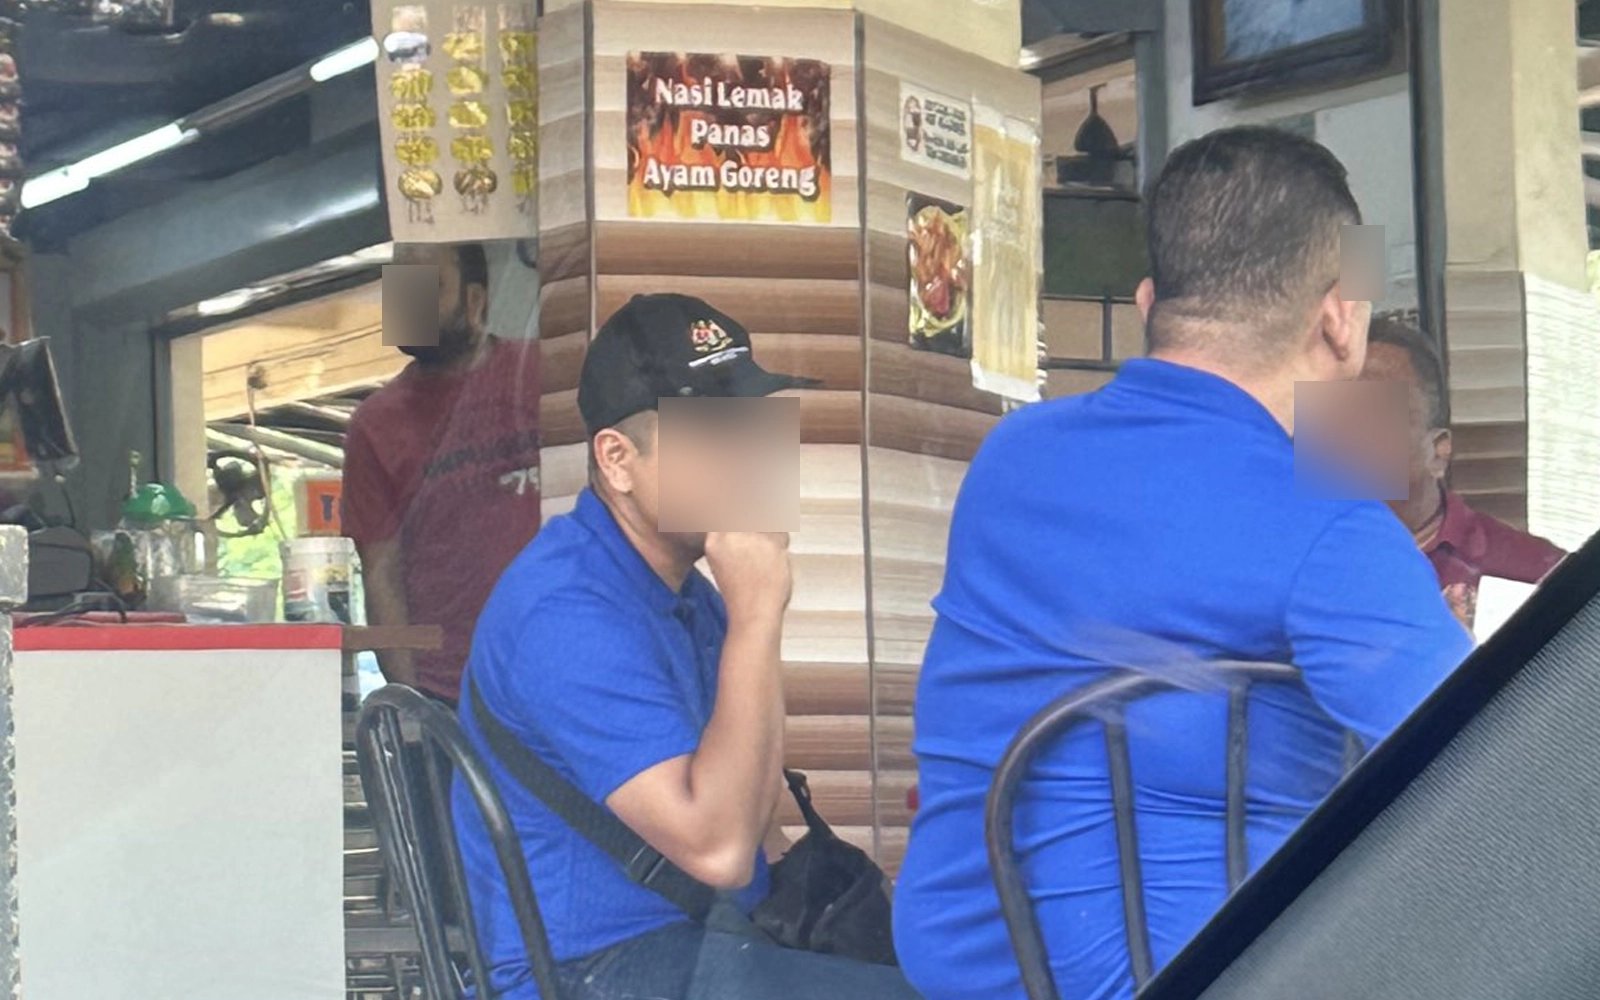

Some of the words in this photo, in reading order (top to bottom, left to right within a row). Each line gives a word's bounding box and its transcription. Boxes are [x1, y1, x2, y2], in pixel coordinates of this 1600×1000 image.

[655, 76, 713, 106] Nasi
[717, 81, 804, 110] Lemak
[690, 119, 771, 147] Panas
[643, 158, 716, 191] Ayam
[720, 160, 817, 196] Goreng
